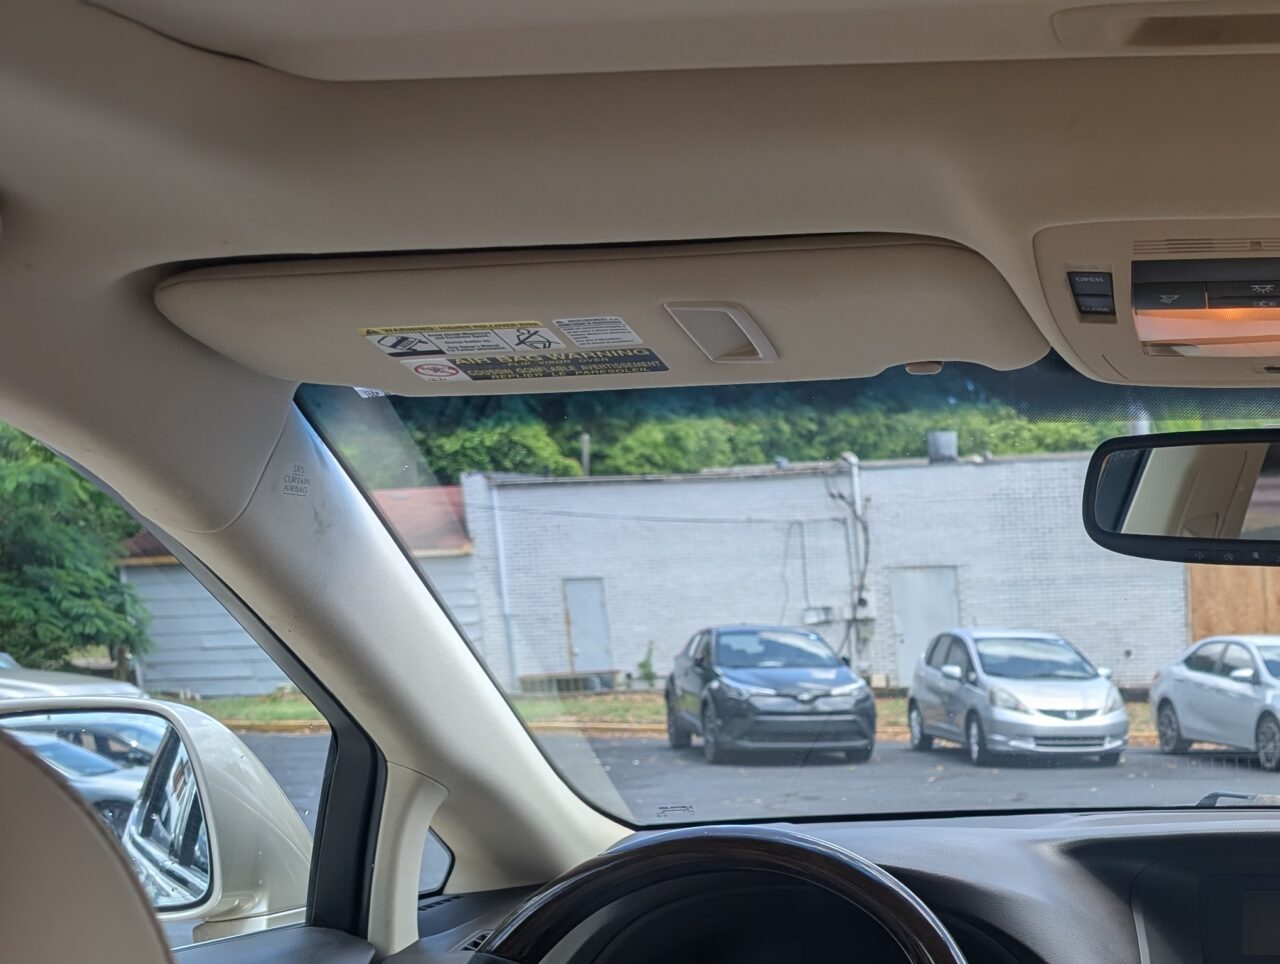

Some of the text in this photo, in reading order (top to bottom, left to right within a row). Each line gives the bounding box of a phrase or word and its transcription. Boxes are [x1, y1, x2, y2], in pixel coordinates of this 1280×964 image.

[455, 349, 650, 365] AIR BAG WARNING
